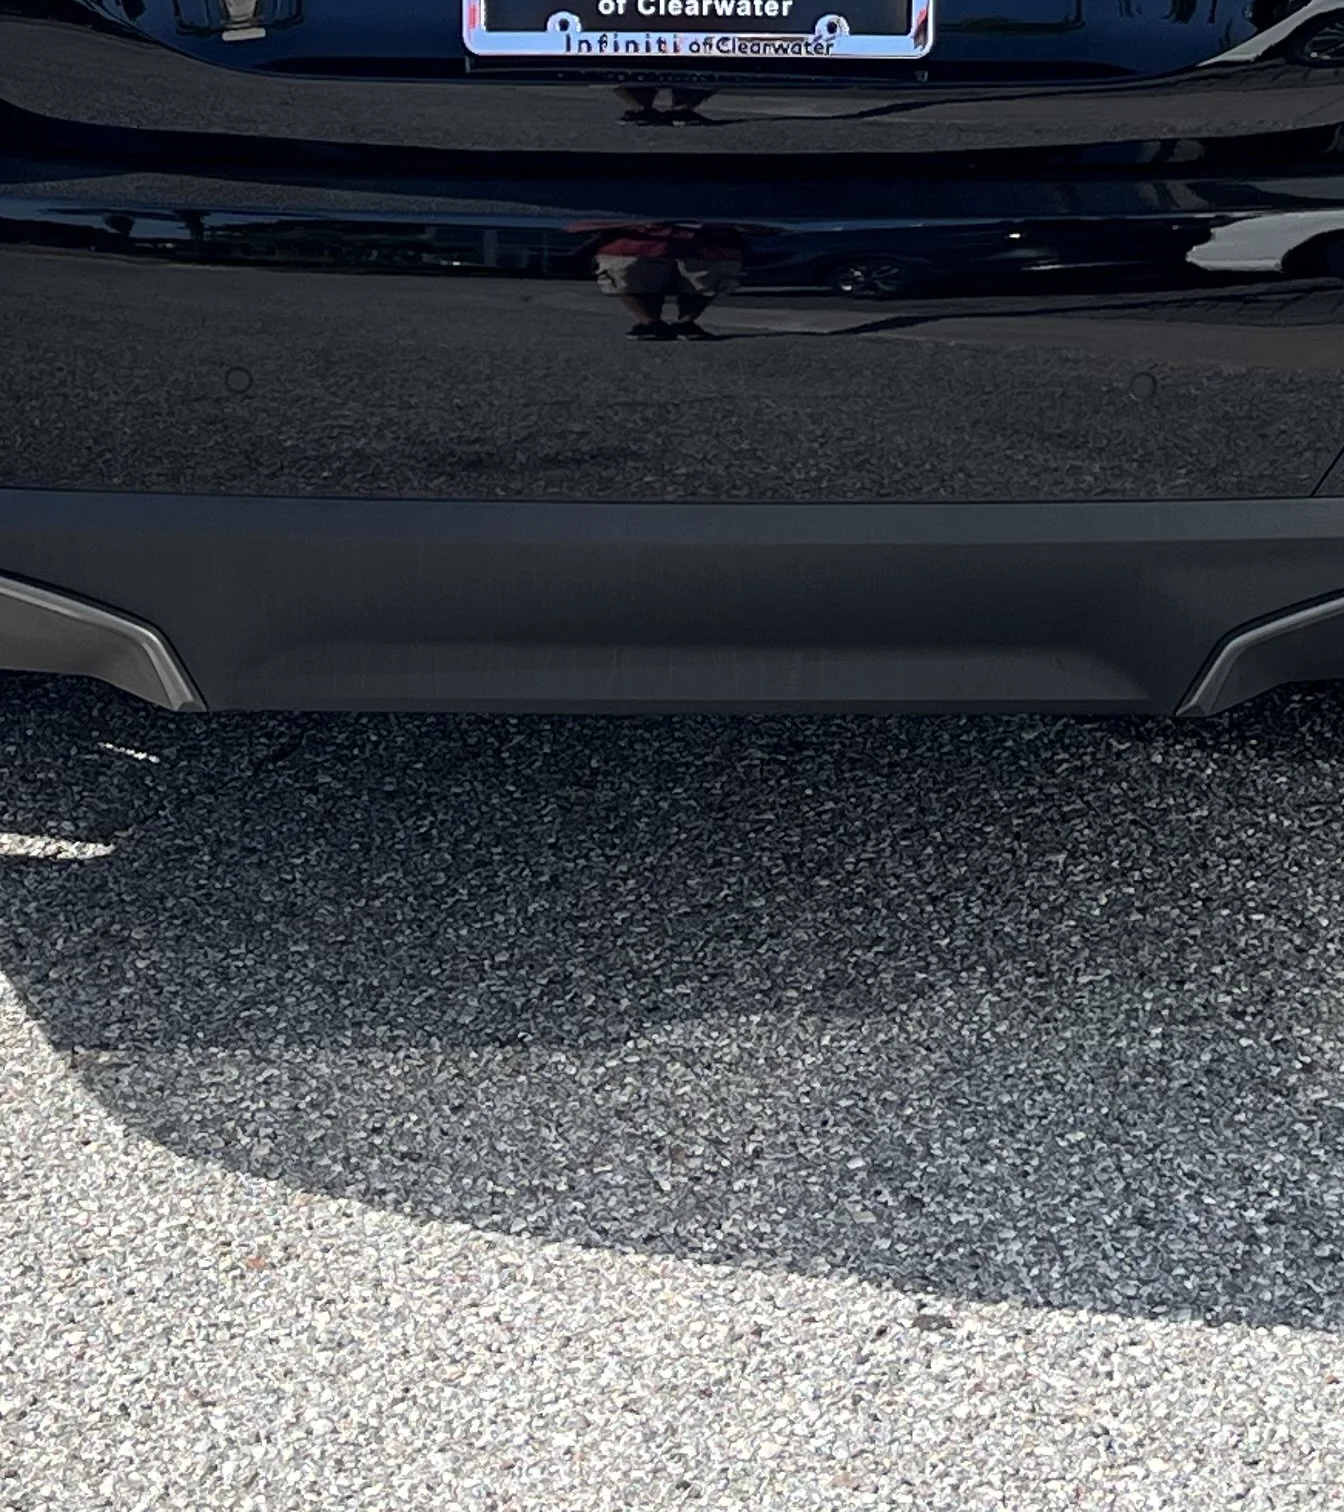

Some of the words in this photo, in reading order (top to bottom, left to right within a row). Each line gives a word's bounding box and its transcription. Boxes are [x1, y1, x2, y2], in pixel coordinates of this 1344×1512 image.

[565, 33, 678, 54] Infiniti
[688, 35, 712, 54] of
[716, 35, 835, 56] Clearwater
